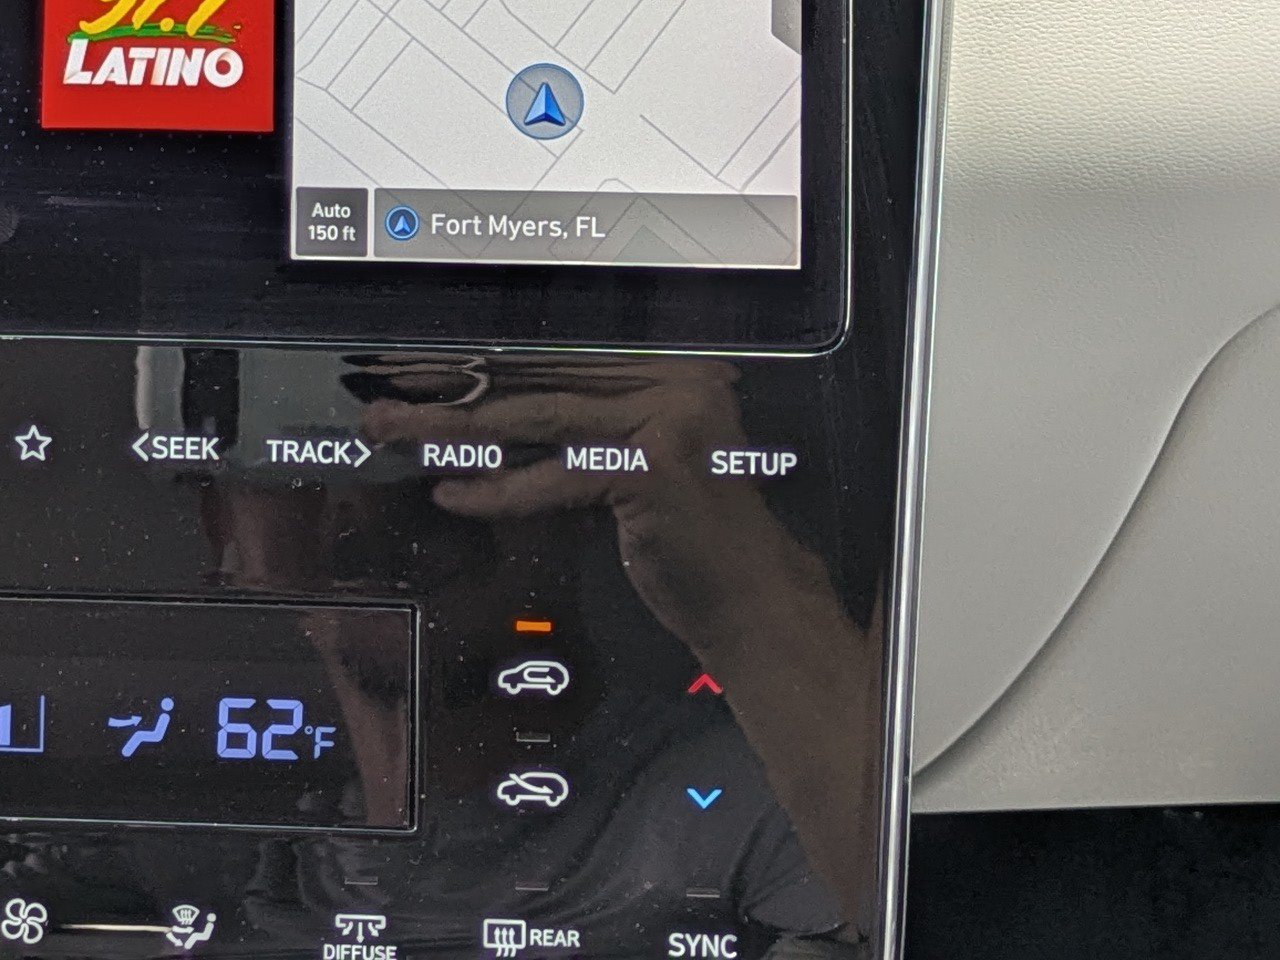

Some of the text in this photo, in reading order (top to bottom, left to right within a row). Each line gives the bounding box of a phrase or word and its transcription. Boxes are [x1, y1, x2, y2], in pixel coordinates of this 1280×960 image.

[311, 202, 351, 219] Auto
[308, 224, 356, 242] 150 ft
[431, 213, 606, 241] Fort Myers, FL
[423, 443, 503, 469] RADIO
[566, 446, 649, 472] MEDIA
[711, 449, 798, 476] SETUP
[529, 928, 581, 948] REAR
[668, 932, 738, 959] SYNC
[323, 943, 397, 960] DIFFUSE
